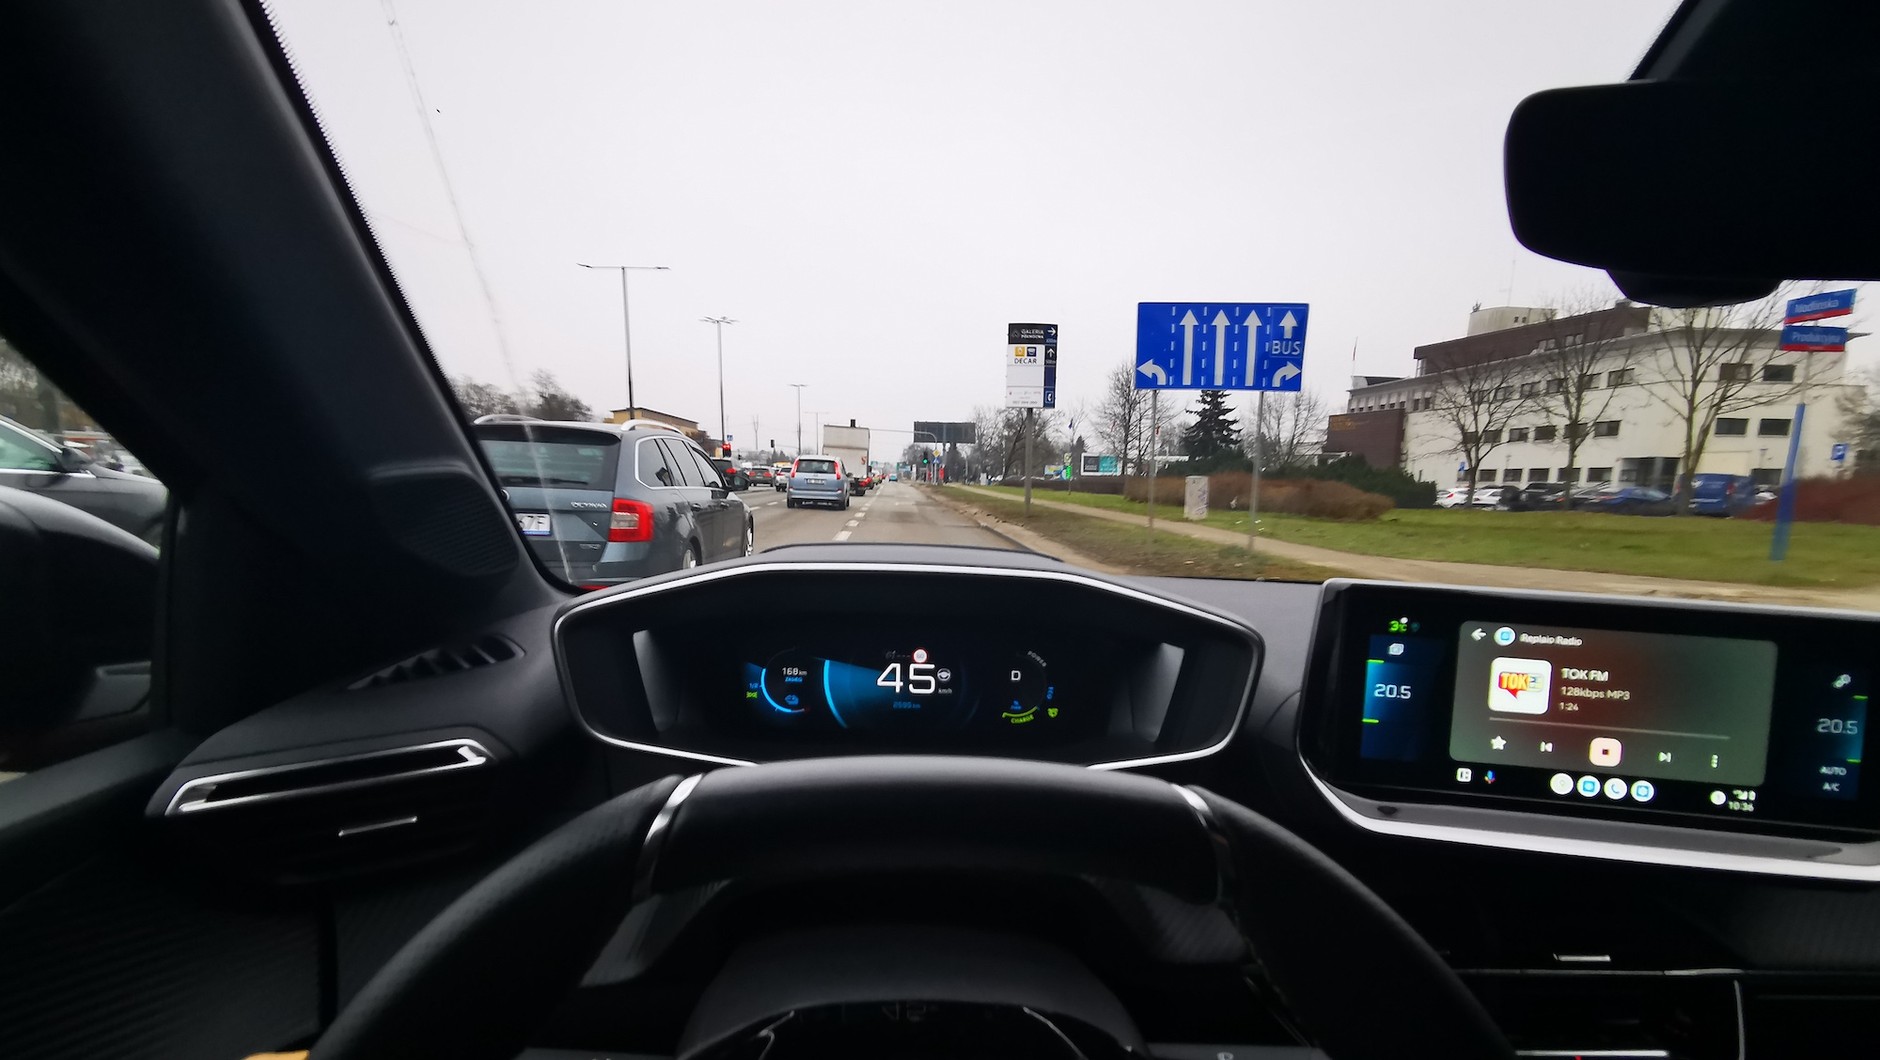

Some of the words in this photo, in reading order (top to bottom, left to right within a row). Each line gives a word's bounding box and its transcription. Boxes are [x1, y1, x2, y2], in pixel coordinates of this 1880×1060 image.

[1272, 340, 1300, 355] BUS
[1556, 637, 1583, 646] Radio
[1027, 651, 1047, 667] POWER
[877, 663, 935, 694] 45
[1011, 670, 1021, 681] D
[1500, 673, 1527, 690] TOK
[1561, 668, 1587, 680] TOK
[1589, 670, 1609, 682] FM
[1374, 683, 1412, 699] 20.5
[1561, 686, 1605, 699] 128kbps
[1606, 690, 1631, 701] MP3
[1010, 714, 1035, 724] CHARGE
[1817, 718, 1859, 735] 20.5
[1819, 766, 1847, 776] AUTO
[1822, 782, 1840, 792] A/C
